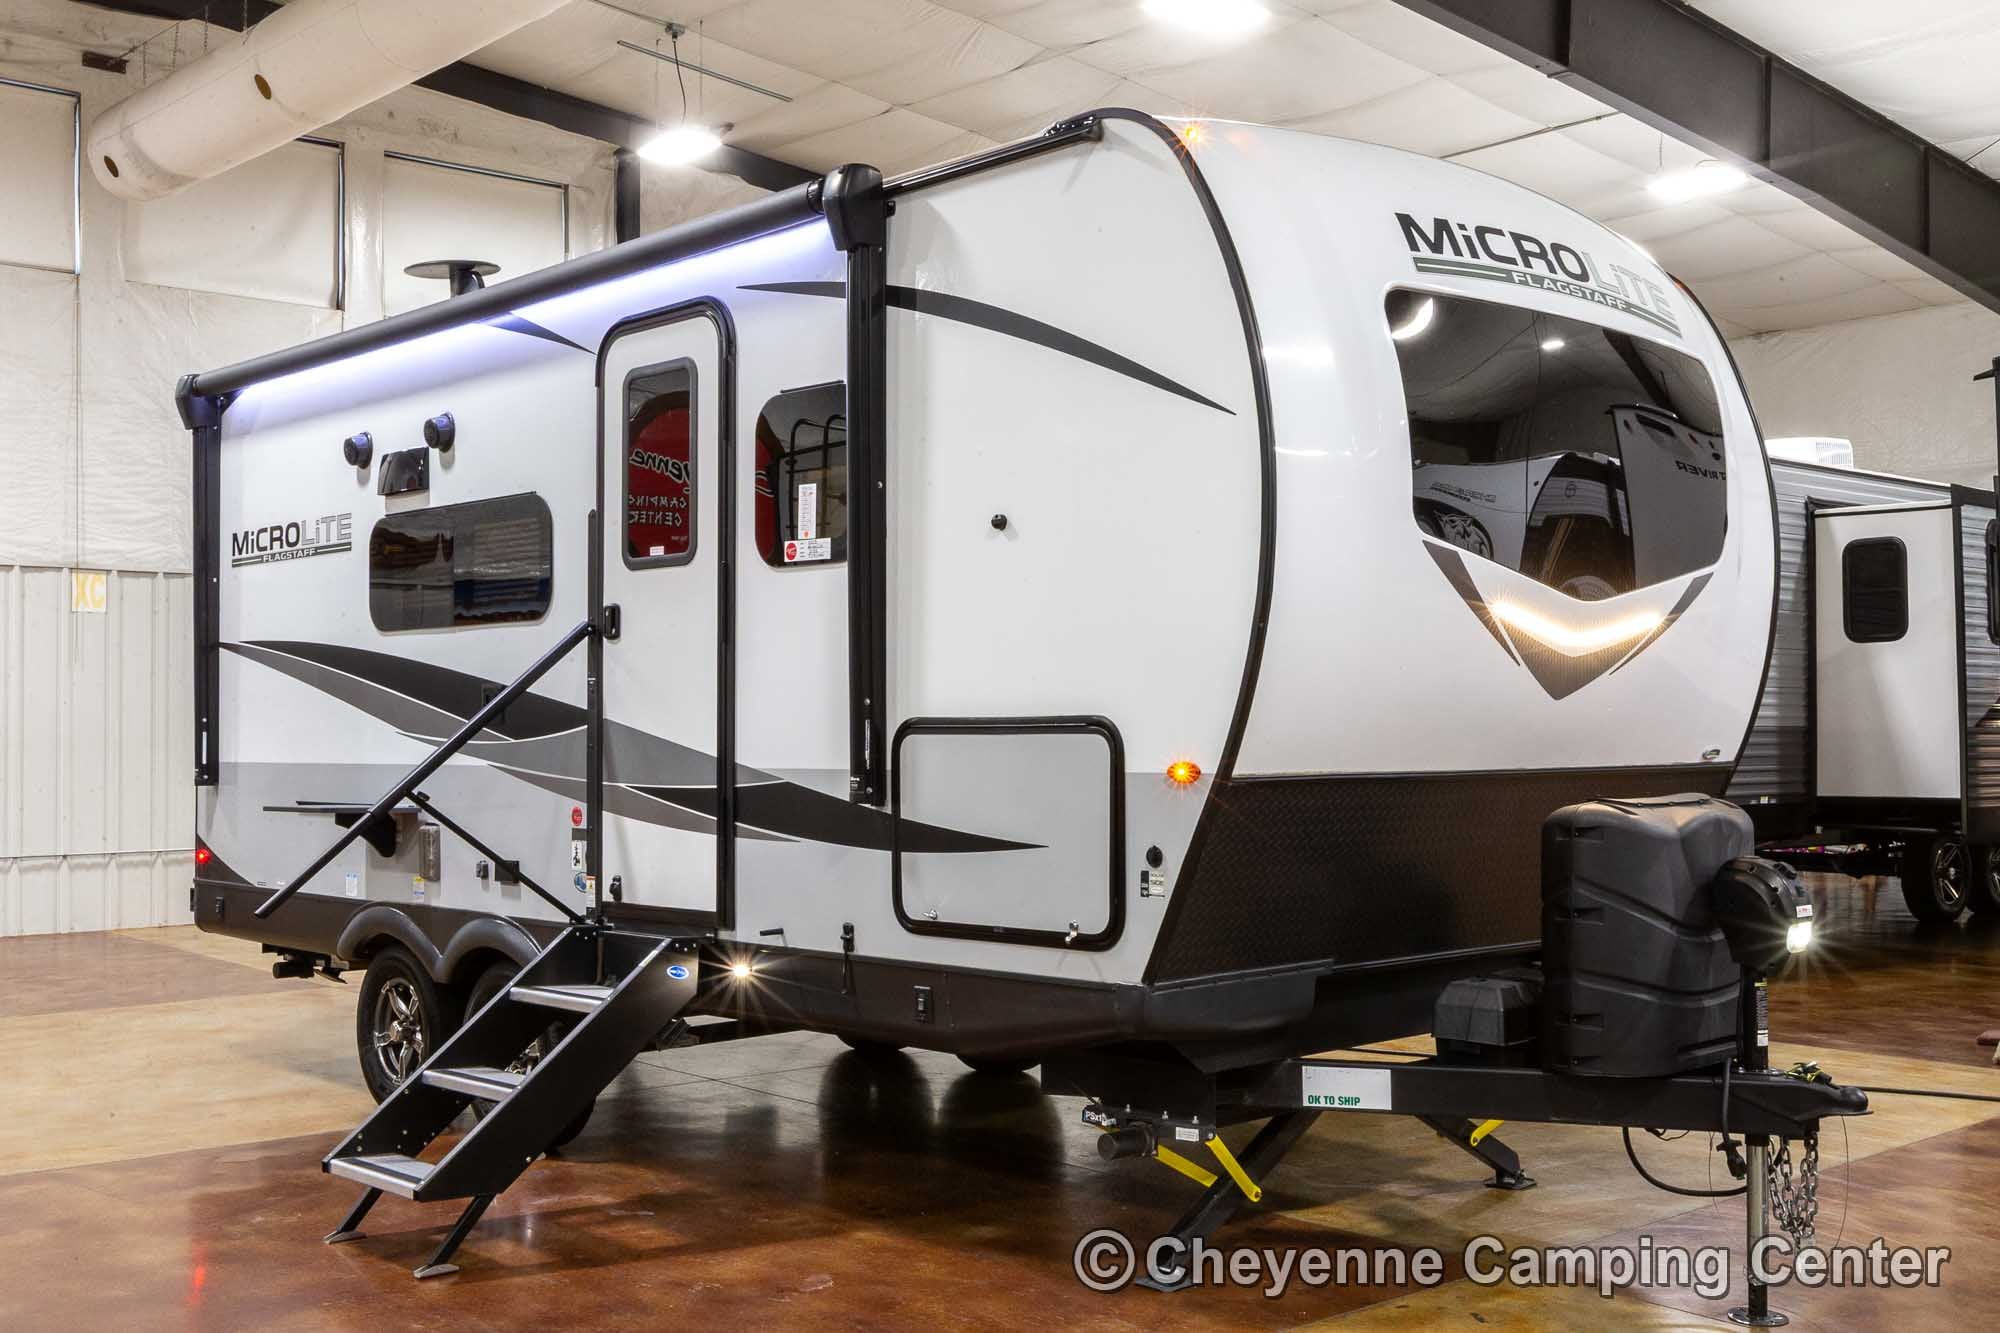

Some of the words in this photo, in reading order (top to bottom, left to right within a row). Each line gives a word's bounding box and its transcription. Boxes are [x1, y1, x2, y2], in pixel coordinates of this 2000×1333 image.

[1510, 270, 1629, 312] FLAGSTAFF
[263, 547, 318, 563] FLAGSTAFF
[1307, 1094, 1321, 1105] OK
[1323, 1095, 1335, 1106] TO
[1337, 1096, 1361, 1107] SHIP
